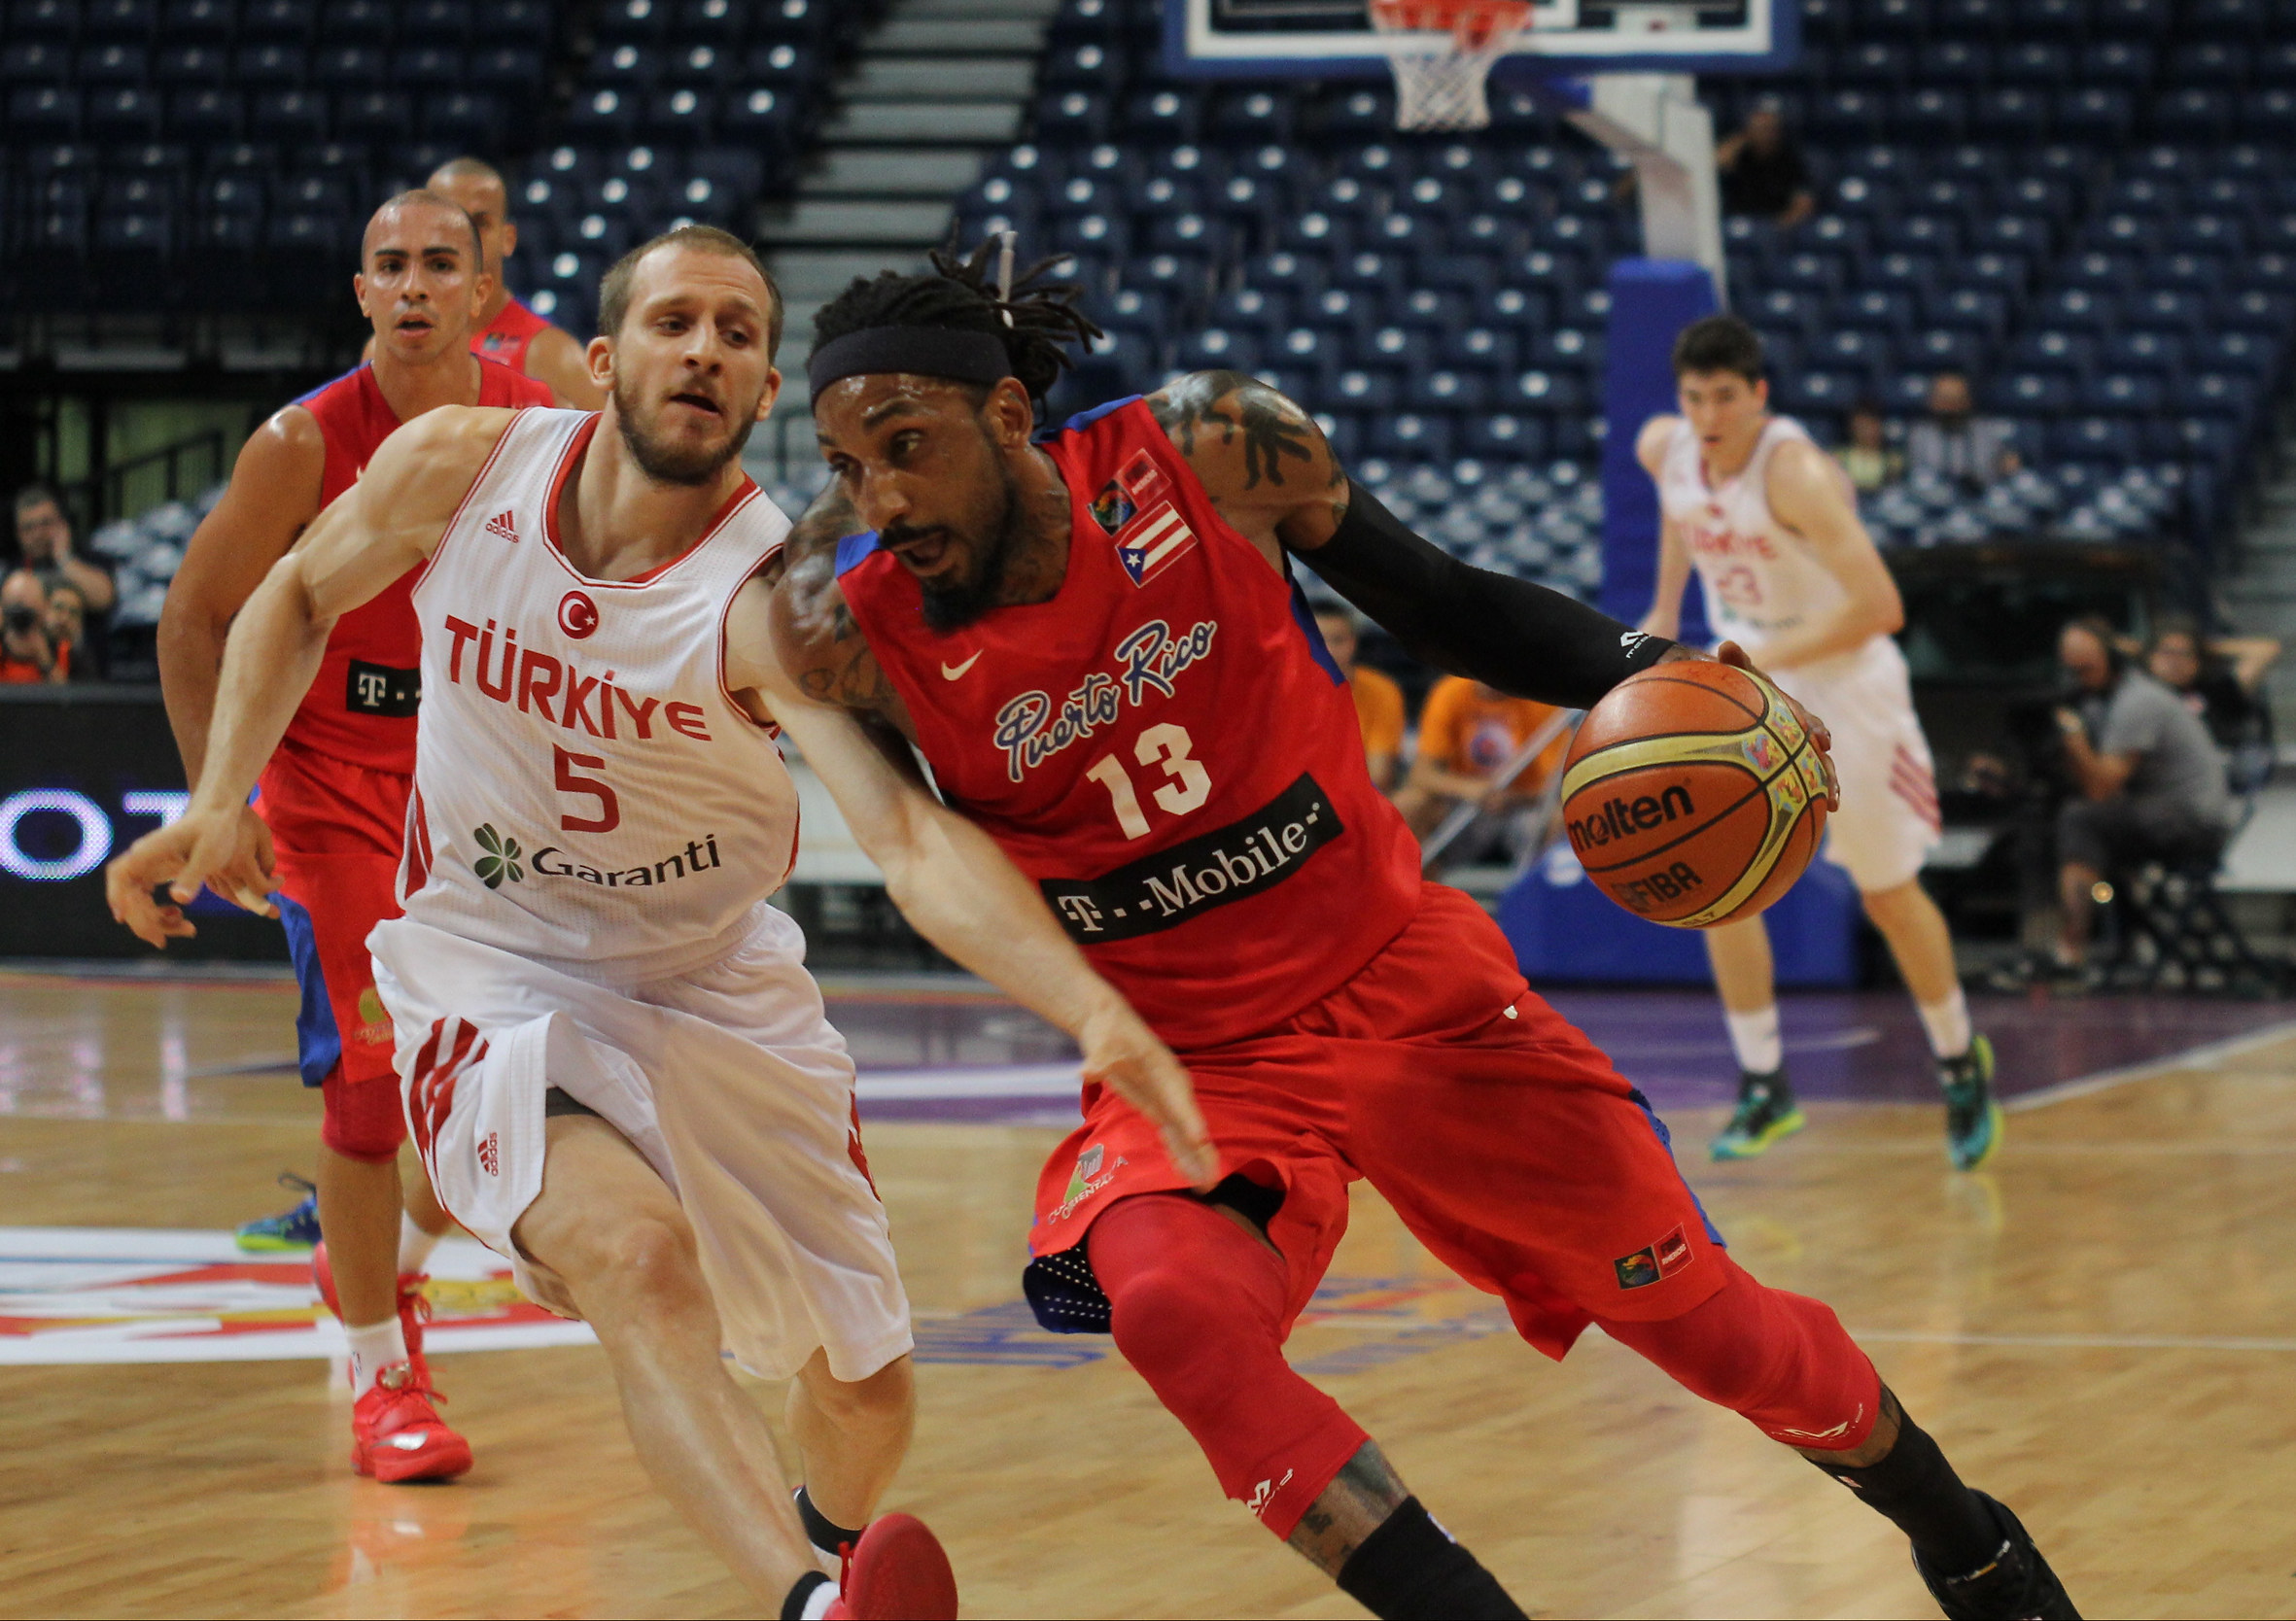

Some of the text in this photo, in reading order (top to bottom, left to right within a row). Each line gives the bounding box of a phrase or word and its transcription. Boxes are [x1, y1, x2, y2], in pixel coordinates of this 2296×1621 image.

[485, 522, 519, 544] adidas
[444, 614, 713, 742] TÜRKİYE
[993, 618, 1218, 783] Puerto Rico
[552, 742, 621, 834] 5
[1086, 722, 1212, 841] 13
[531, 833, 721, 887] Garanti
